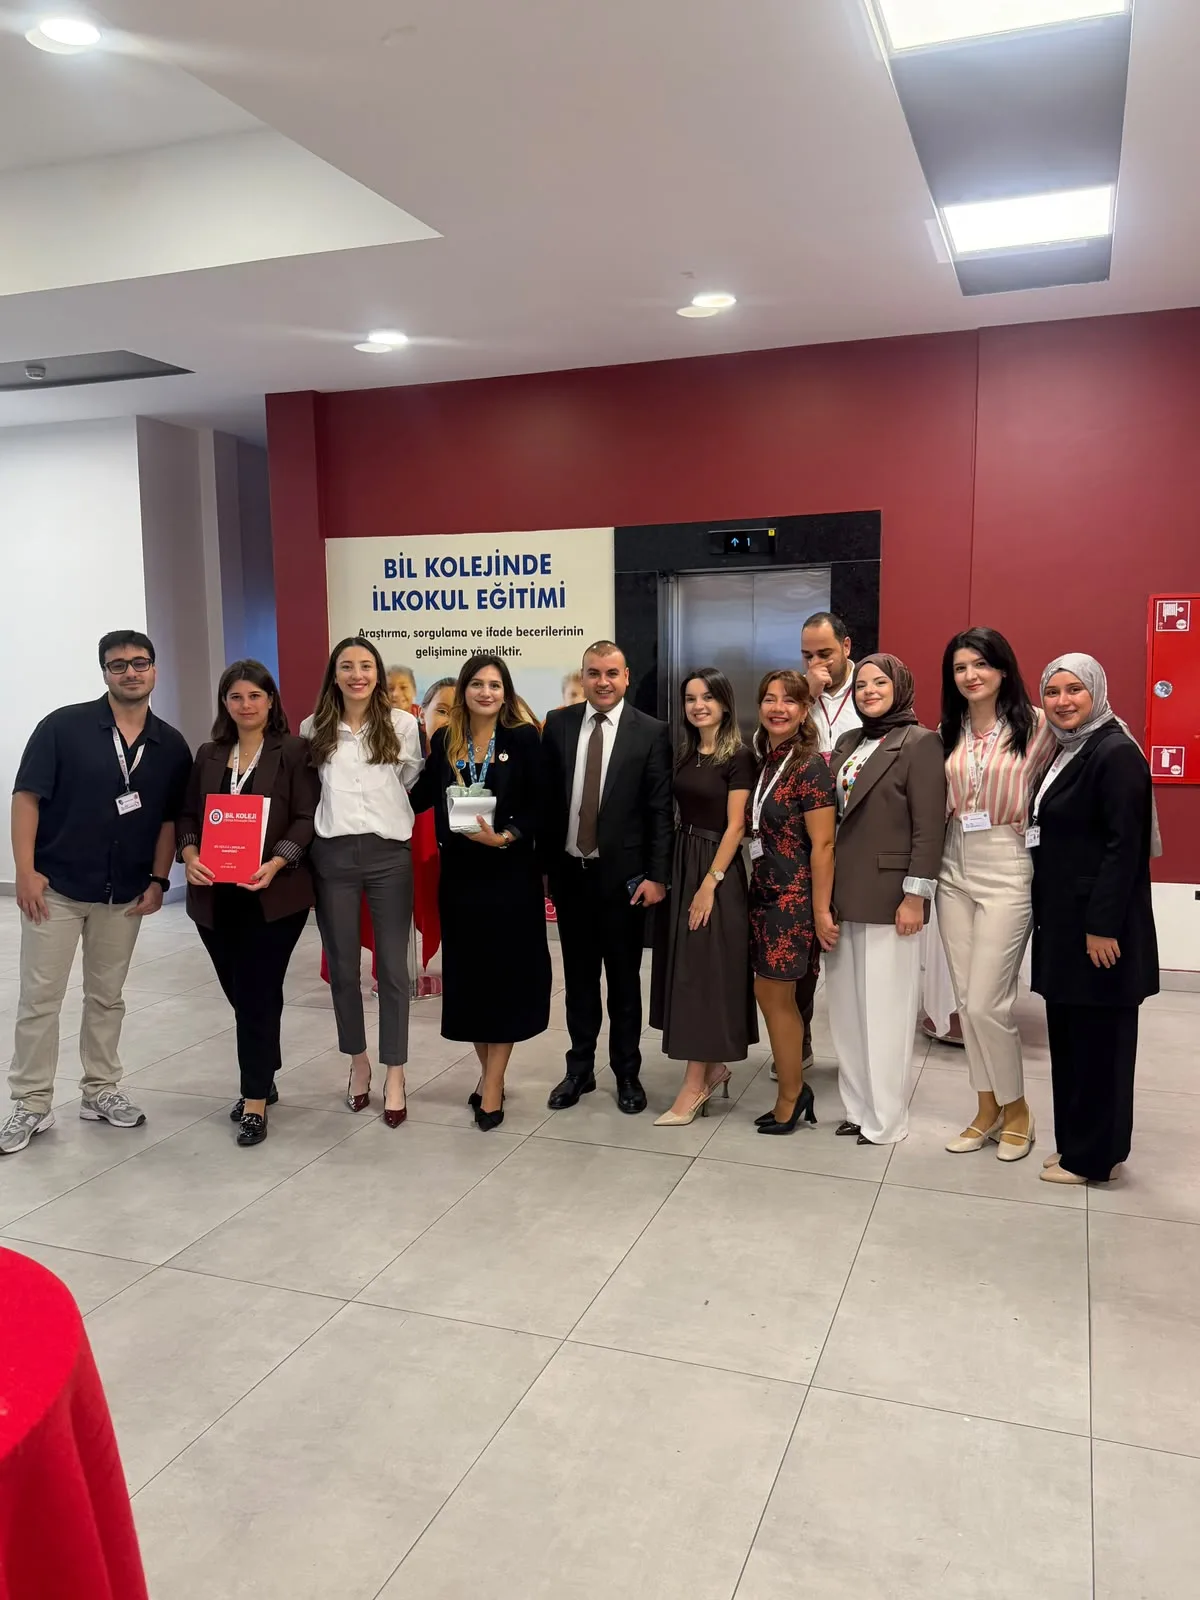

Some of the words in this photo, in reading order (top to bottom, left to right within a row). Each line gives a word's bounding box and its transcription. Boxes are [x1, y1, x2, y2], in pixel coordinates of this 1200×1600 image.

[384, 551, 418, 579] BİL
[425, 548, 552, 578] KOLEJİNDE
[372, 585, 469, 612] İLKOKUL
[476, 580, 566, 610] EĞİTİMİ
[358, 628, 411, 640] Araştırma,
[413, 627, 468, 640] sorgulama
[471, 628, 483, 637] ve
[486, 626, 513, 637] ifade
[516, 625, 584, 637] becerilerinin
[415, 646, 468, 659] gelişimine
[470, 645, 522, 657] yöneliktir.
